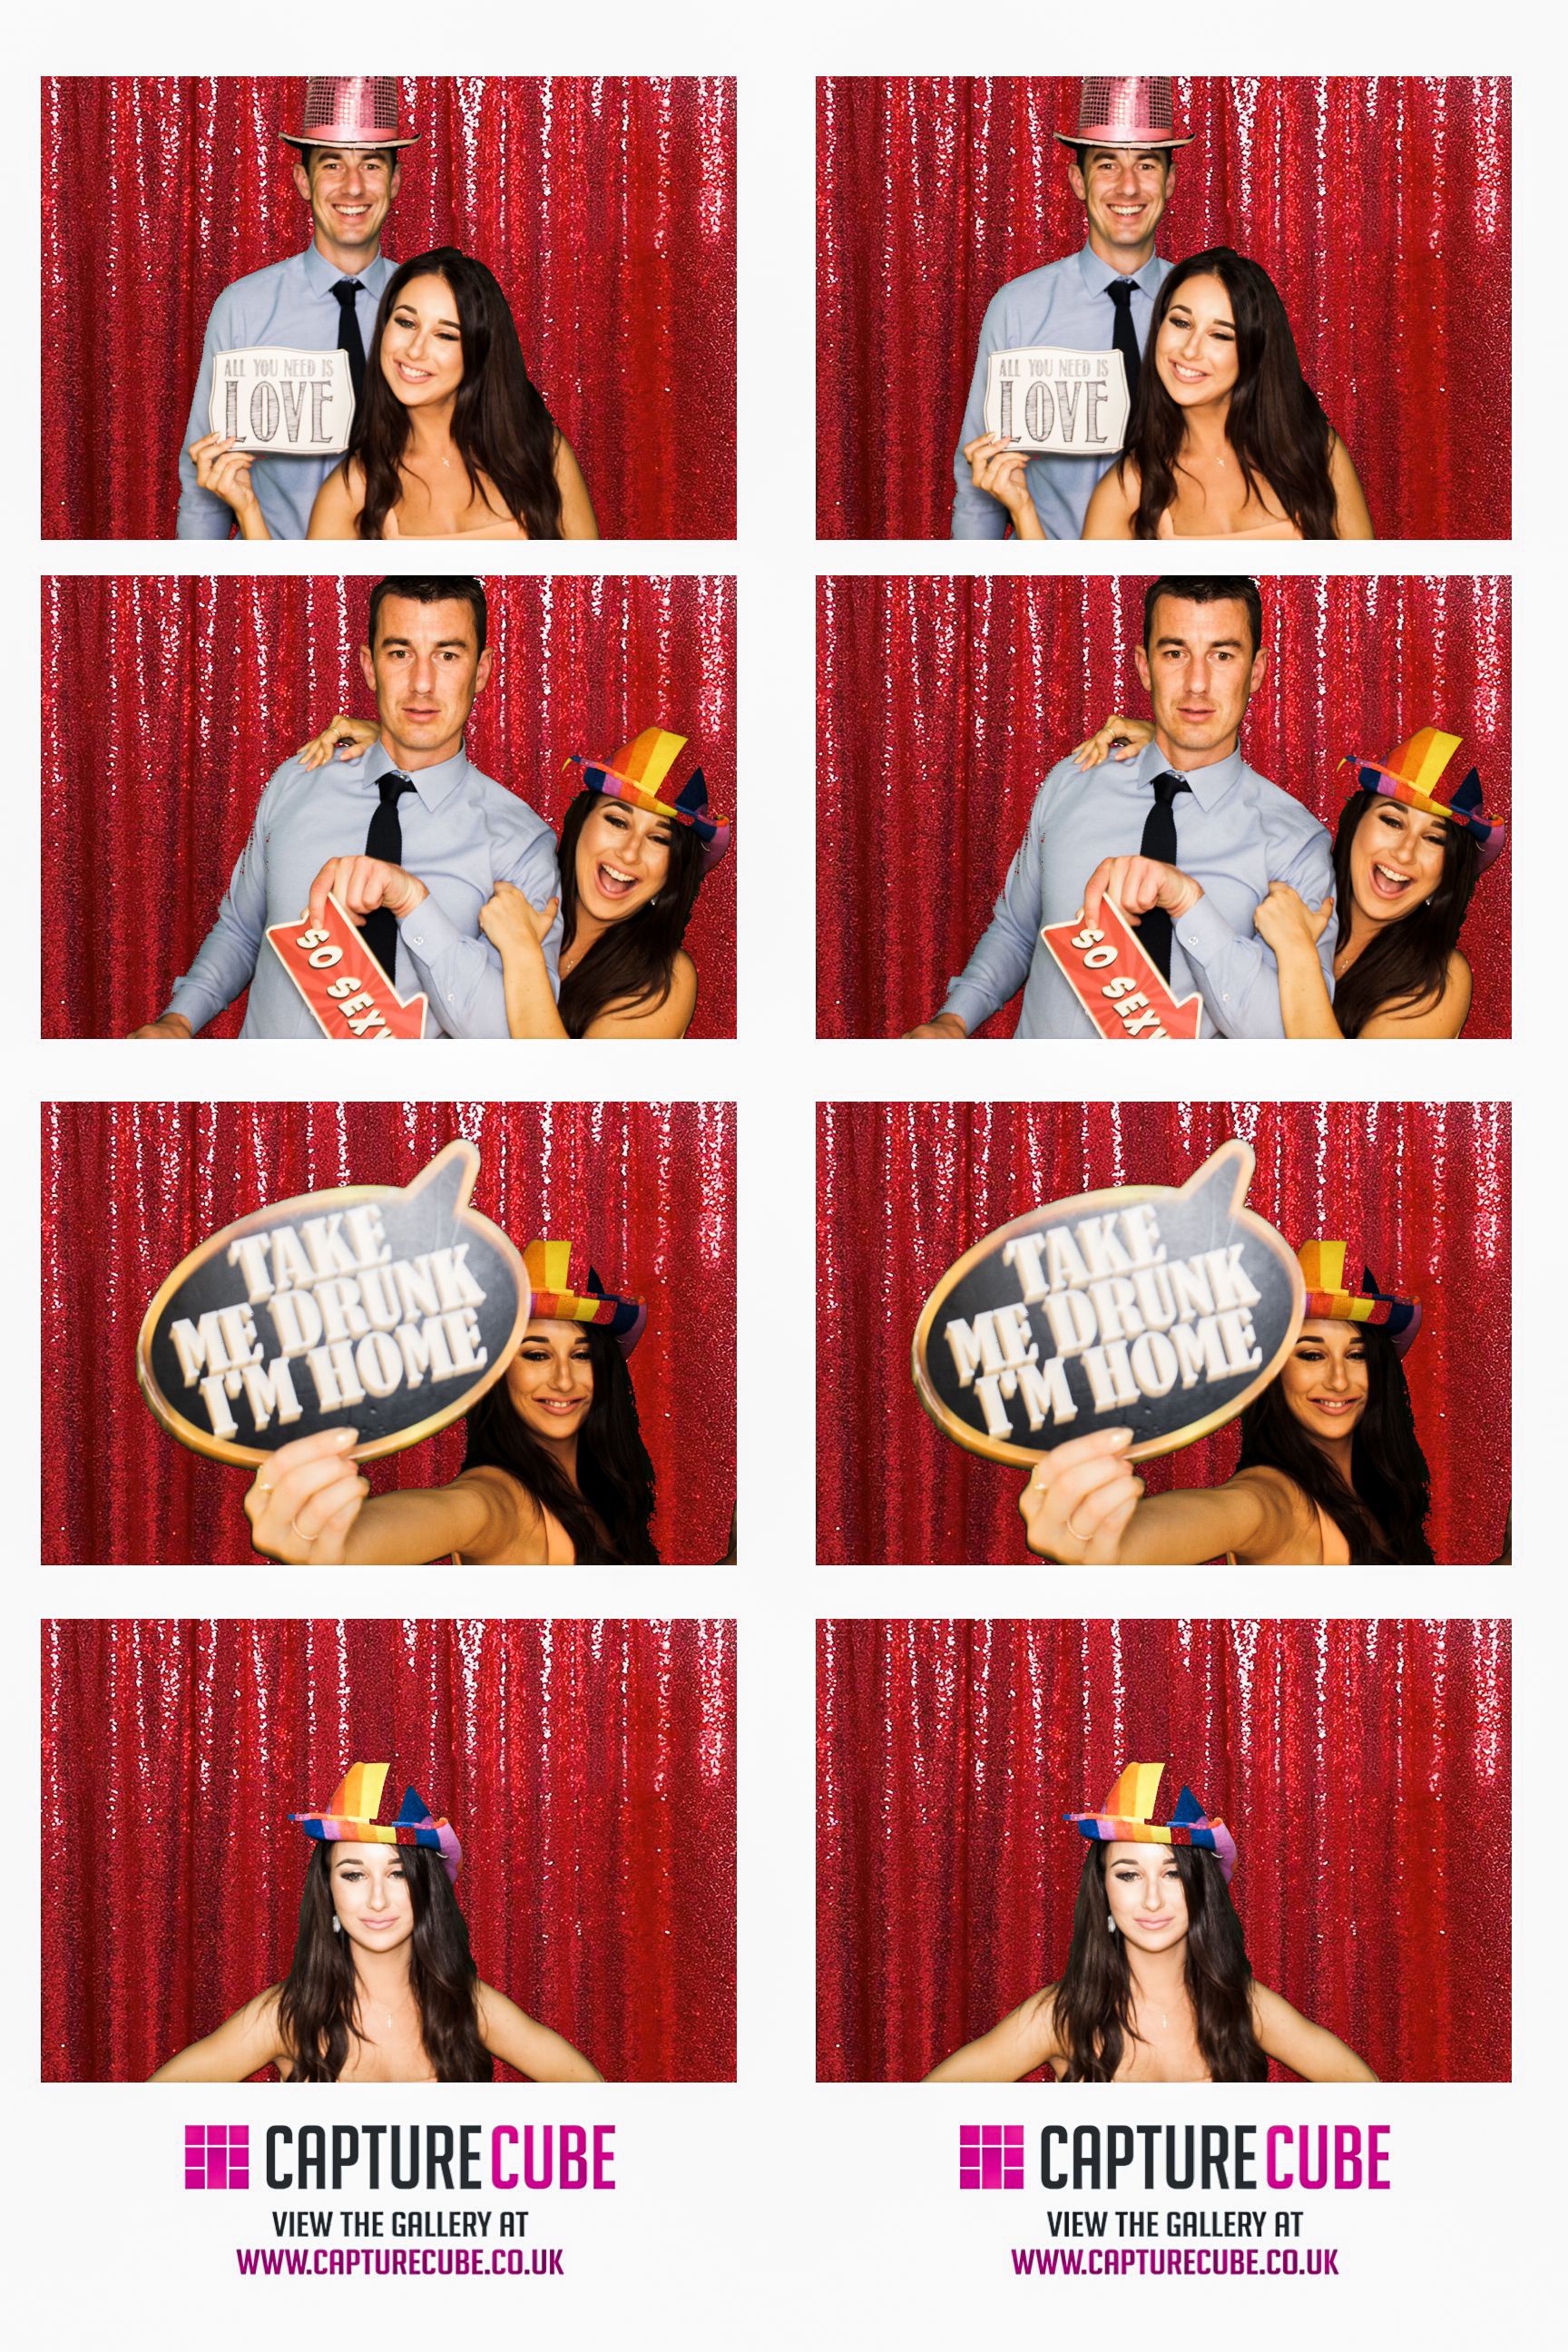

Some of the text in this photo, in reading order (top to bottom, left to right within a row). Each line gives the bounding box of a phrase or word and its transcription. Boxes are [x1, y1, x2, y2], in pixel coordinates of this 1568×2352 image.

[224, 358, 334, 377] ALL YOU NEED IS
[999, 358, 1109, 377] ALL YOU NEED IS
[225, 380, 333, 443] LOVE
[1000, 380, 1108, 443] LOVE
[296, 928, 343, 969] SO
[1071, 928, 1118, 969] SO
[227, 1203, 392, 1305] TAKE
[1002, 1203, 1167, 1305] TAKE
[169, 1242, 486, 1387] ME DRUNK
[944, 1242, 1261, 1387] ME DRUNK
[199, 1307, 488, 1442] I'M HOME
[974, 1307, 1263, 1442] I'M HOME
